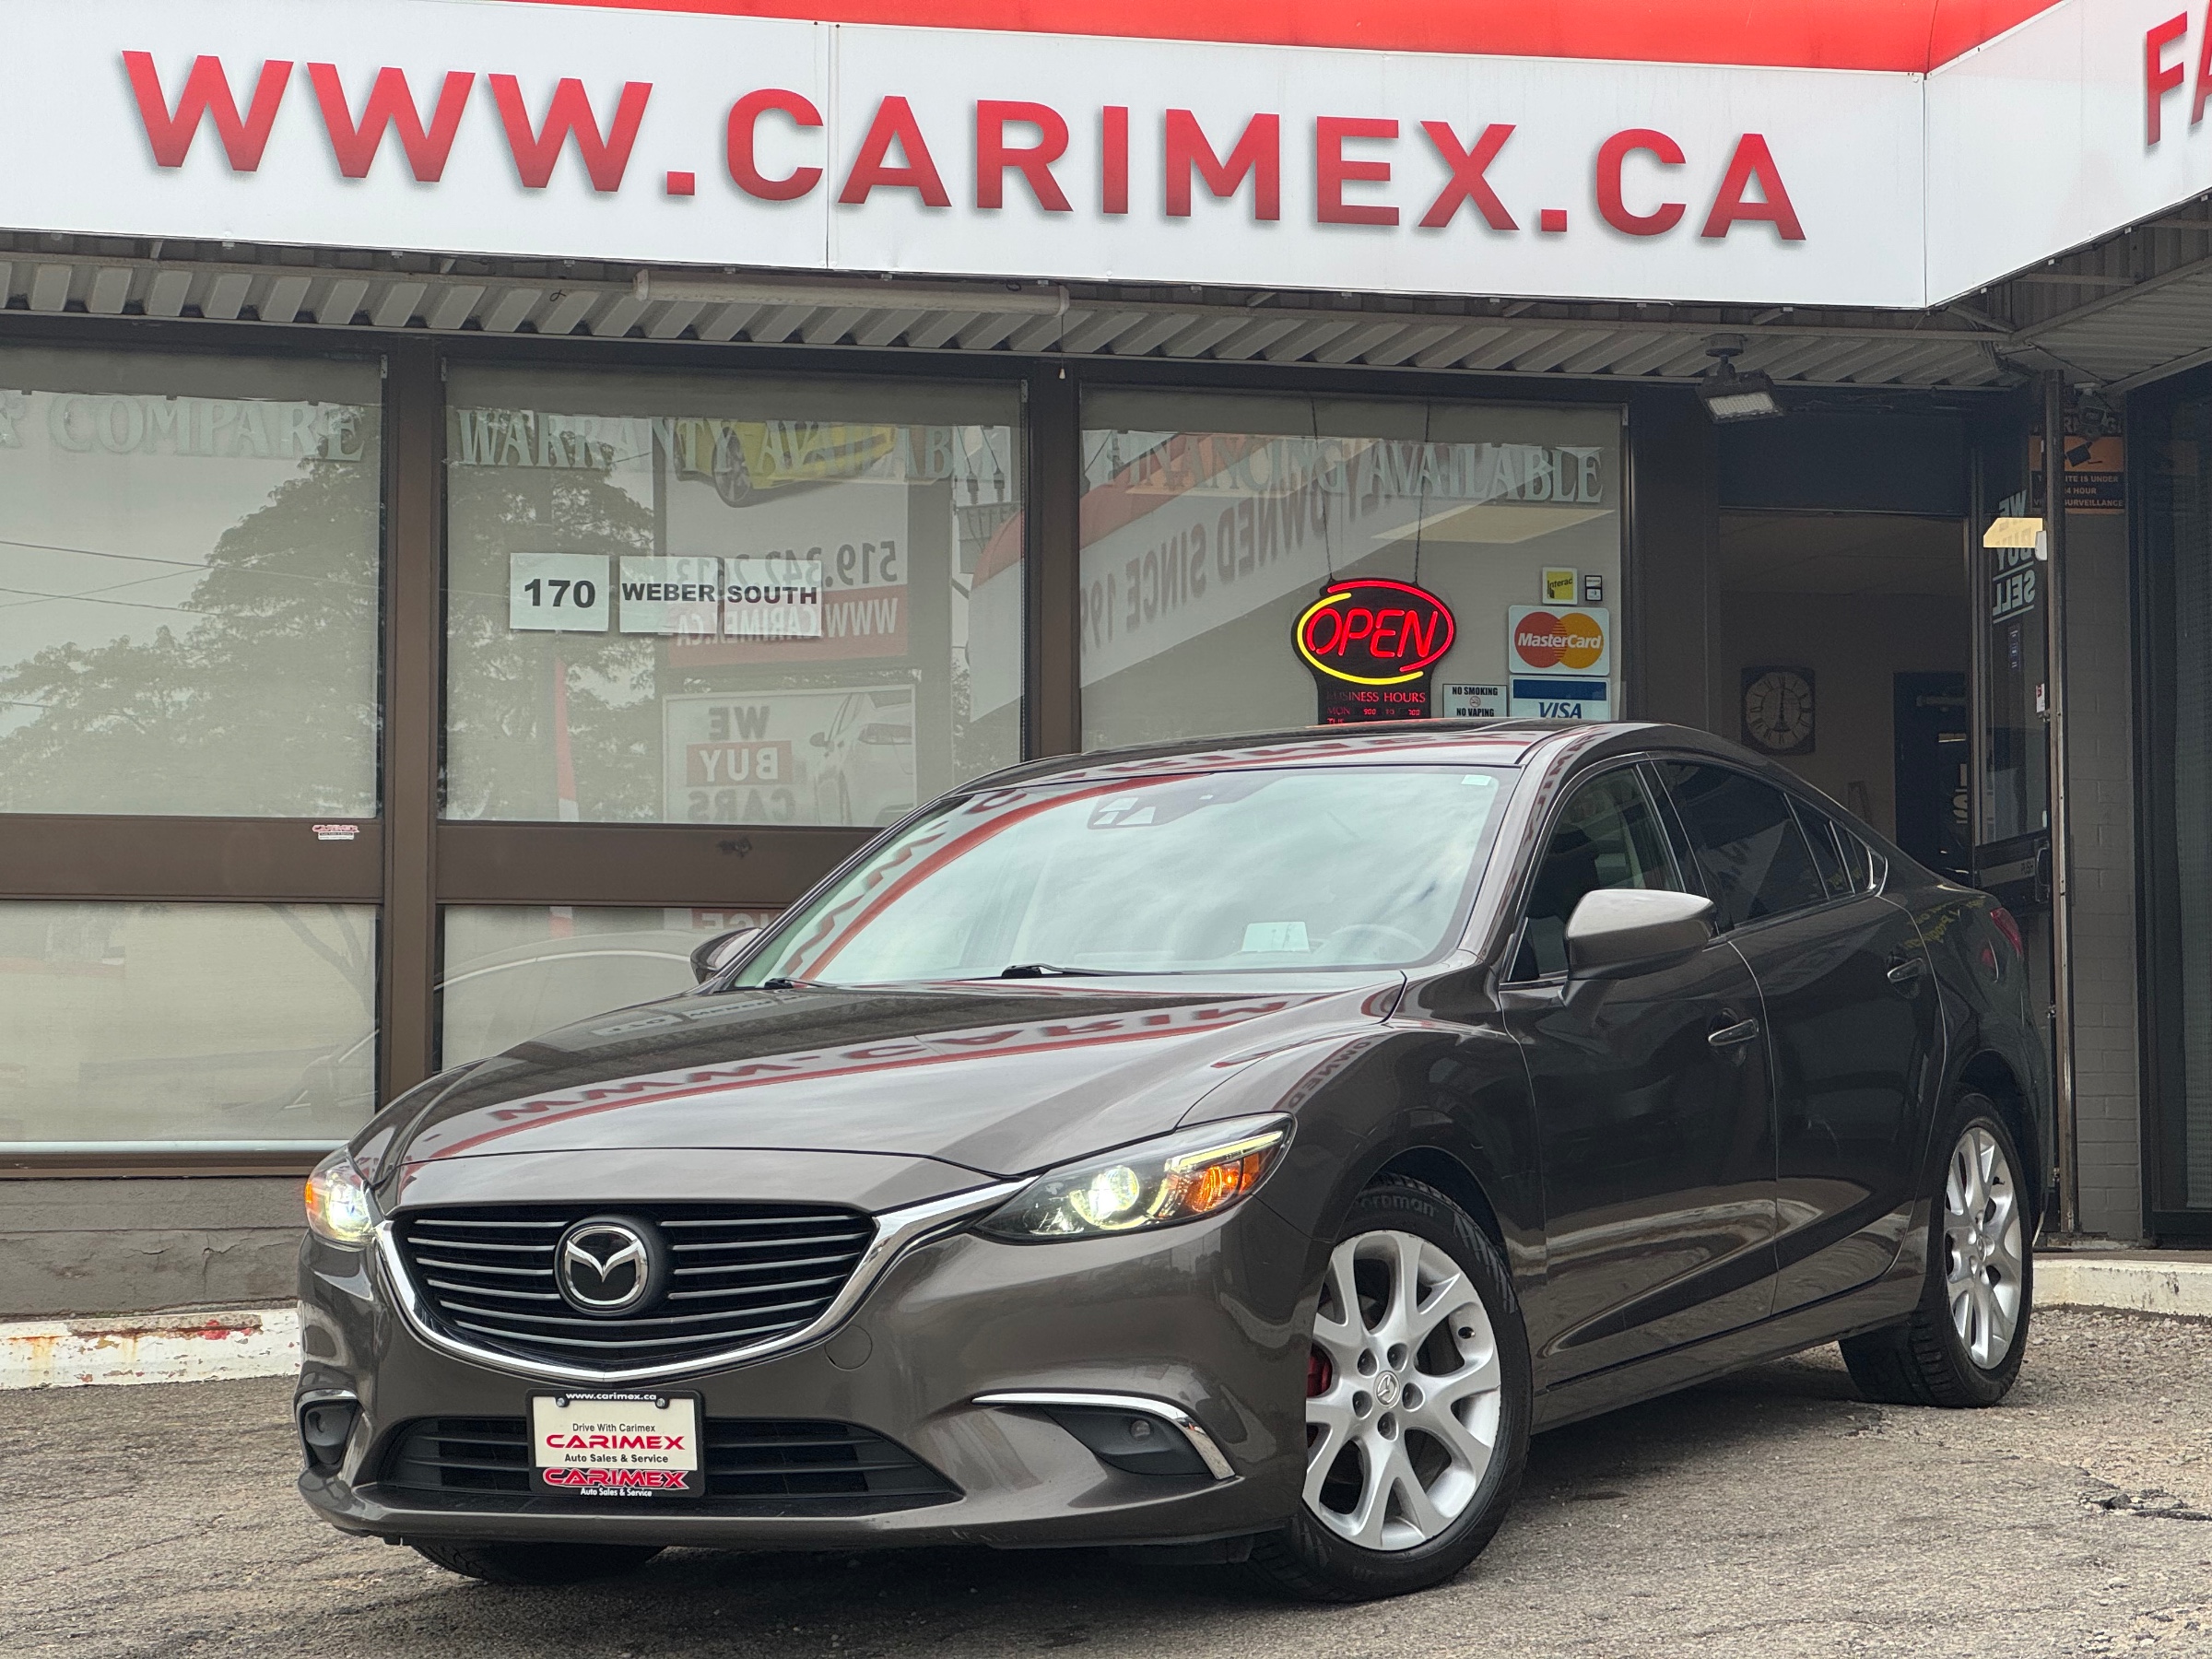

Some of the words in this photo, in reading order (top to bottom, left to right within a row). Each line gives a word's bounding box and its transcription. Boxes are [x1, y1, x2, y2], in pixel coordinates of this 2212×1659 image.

[122, 50, 1806, 241] WWW.CARIMEX.CA
[48, 395, 366, 461] COMPARE
[457, 409, 737, 471] WARRANTY
[1366, 441, 1604, 503] AVAILABLE
[1547, 577, 1573, 589] Interac
[524, 578, 596, 609] 170
[621, 582, 716, 603] WEBER
[726, 585, 818, 606] SOUTH
[1306, 607, 1440, 658] OPEN
[1518, 632, 1602, 649] MasterCard
[1326, 691, 1380, 702] BUSINESS
[1383, 692, 1426, 703] HOURS
[1452, 687, 1463, 695] NO
[1464, 687, 1499, 696] SMOKING
[1327, 707, 1350, 715] MON
[1456, 708, 1466, 716] NO
[1467, 708, 1495, 717] VAPING
[1538, 701, 1583, 718] VISA
[566, 1393, 657, 1401] www.carimex.ca
[572, 1423, 594, 1431] Drive
[597, 1423, 617, 1432] With
[619, 1423, 655, 1432] Carimex
[546, 1434, 686, 1450] CARIMEX
[564, 1453, 587, 1463] Auto
[590, 1453, 618, 1463] Sales
[620, 1454, 628, 1463] &
[630, 1453, 669, 1464] Service
[543, 1467, 689, 1489] CARIMEX
[581, 1488, 598, 1496] Auto
[599, 1488, 618, 1497] Sales
[619, 1488, 626, 1497] &
[627, 1488, 653, 1497] Service
